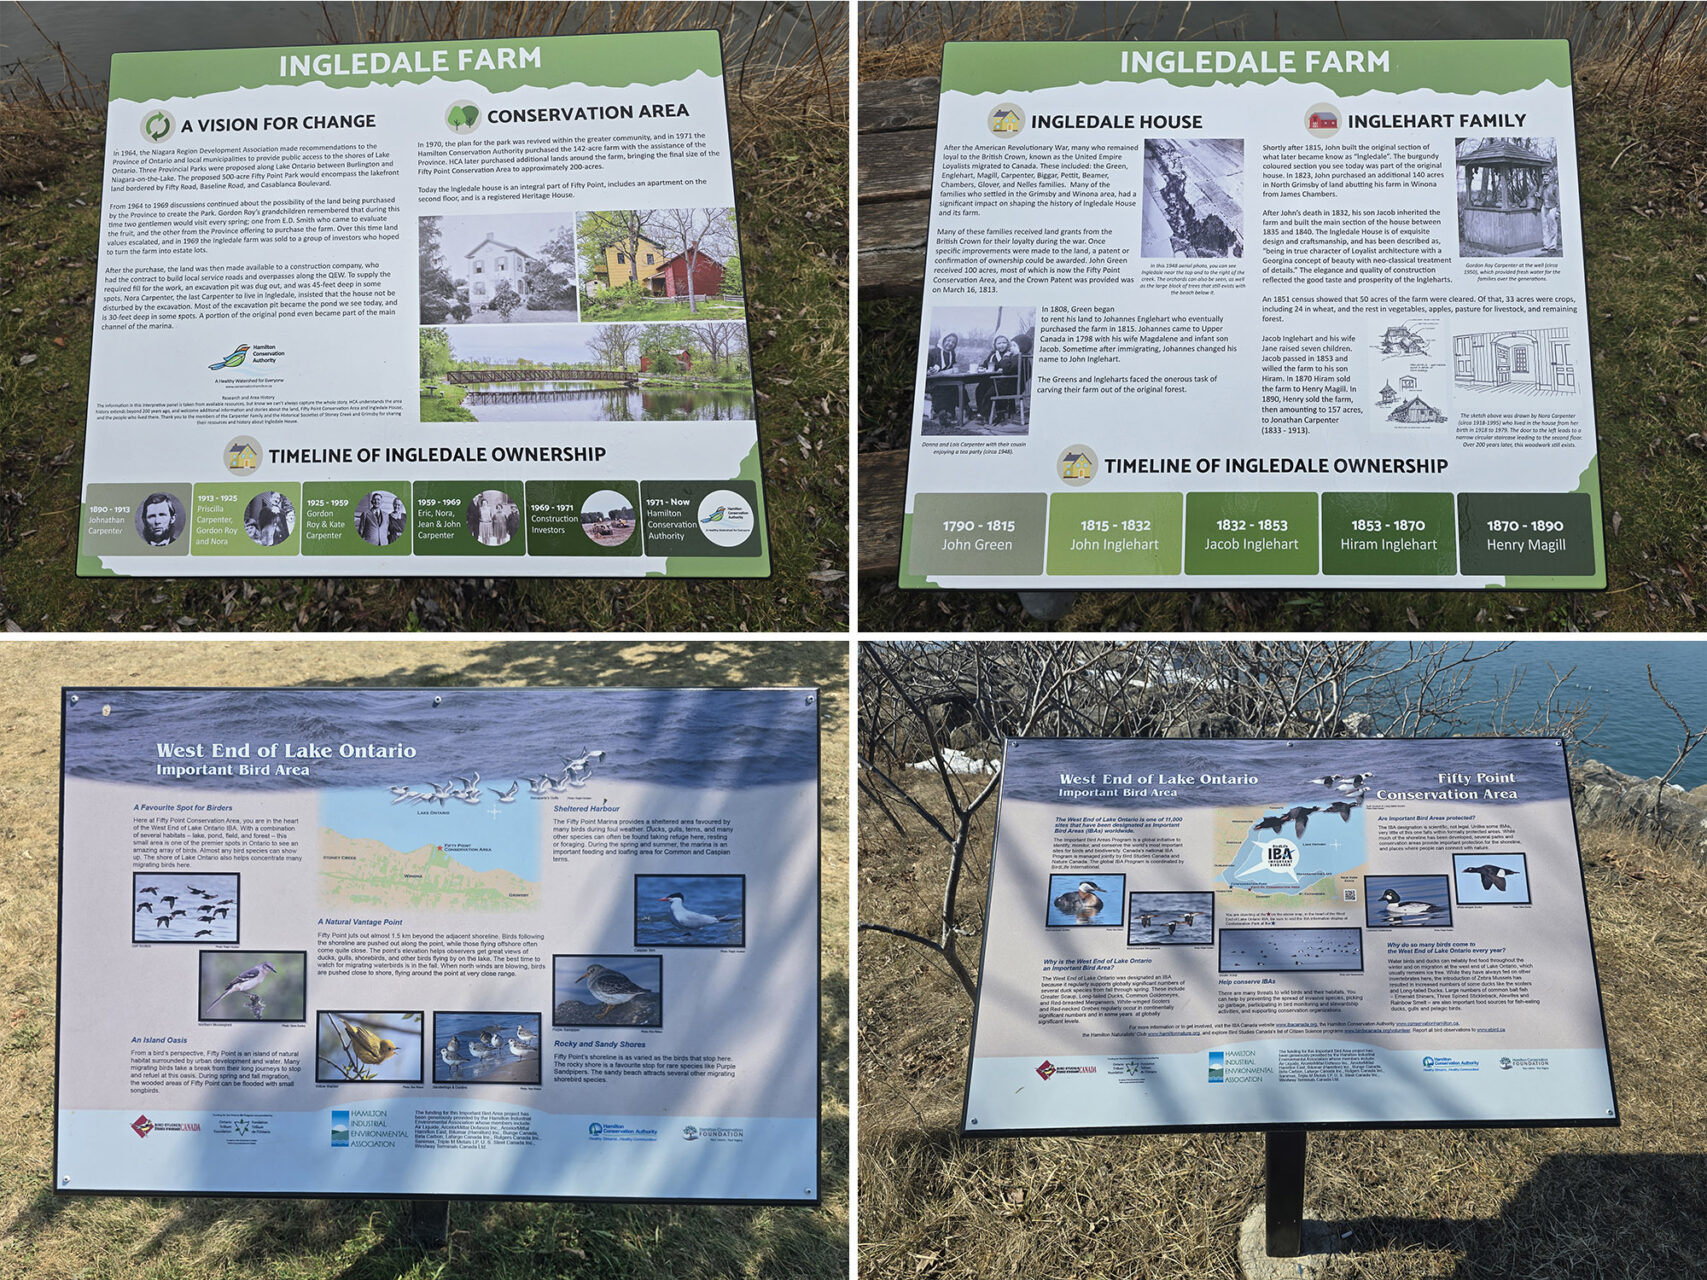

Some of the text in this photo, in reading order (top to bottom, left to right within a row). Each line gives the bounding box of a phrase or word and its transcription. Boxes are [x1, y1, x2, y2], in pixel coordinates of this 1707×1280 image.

[280, 46, 541, 77] INGLEDALE FARM
[1122, 50, 1390, 73] INGLEDALE FARM
[488, 104, 690, 123] CONSERVATION AREA
[181, 115, 376, 133] A VISION FOR CHANGE
[1032, 115, 1203, 129] INGLEDALE HOUSE
[1349, 114, 1526, 128] INGLEHART FAMILY
[269, 447, 606, 463] TIMELINE OF INGLEDALE OWNERSHIP
[1105, 458, 1448, 473] TIMELINE OF INGLEDALE OWNERSHIP
[307, 521, 320, 529] Roy
[648, 520, 699, 528] Conservation
[944, 521, 974, 531] 1790
[987, 520, 1015, 532] 1815
[1081, 520, 1109, 532] 1815
[1122, 520, 1151, 531] 1832
[1217, 519, 1246, 531] 1832
[1258, 519, 1288, 531] 1853
[1352, 519, 1382, 532] 1853
[1394, 520, 1425, 531] 1870
[1487, 520, 1519, 532] 1870
[1531, 520, 1564, 532] 1890
[194, 526, 239, 536] Gordon Roy
[306, 532, 342, 540] Carpenter
[418, 532, 454, 540] Carpenter
[649, 532, 684, 541] Authority
[942, 539, 1012, 550] John Green
[1070, 538, 1159, 552] John Inglehart
[1205, 536, 1299, 552] Jacob Inglehart
[1341, 537, 1438, 553] Hiram Inglehart
[1488, 539, 1566, 553] Henry Magill
[157, 743, 416, 758] West End of Lake Ontario
[157, 765, 309, 778] Important Bird Area
[1061, 774, 1258, 784] West End of Lake Ontario
[1439, 773, 1515, 785] Fifty Point
[1060, 789, 1117, 798] Important
[1375, 789, 1517, 802] Conservation Area
[1269, 848, 1294, 861] IBA
[554, 1040, 578, 1048] Rocky
[595, 1041, 618, 1049] Sandy
